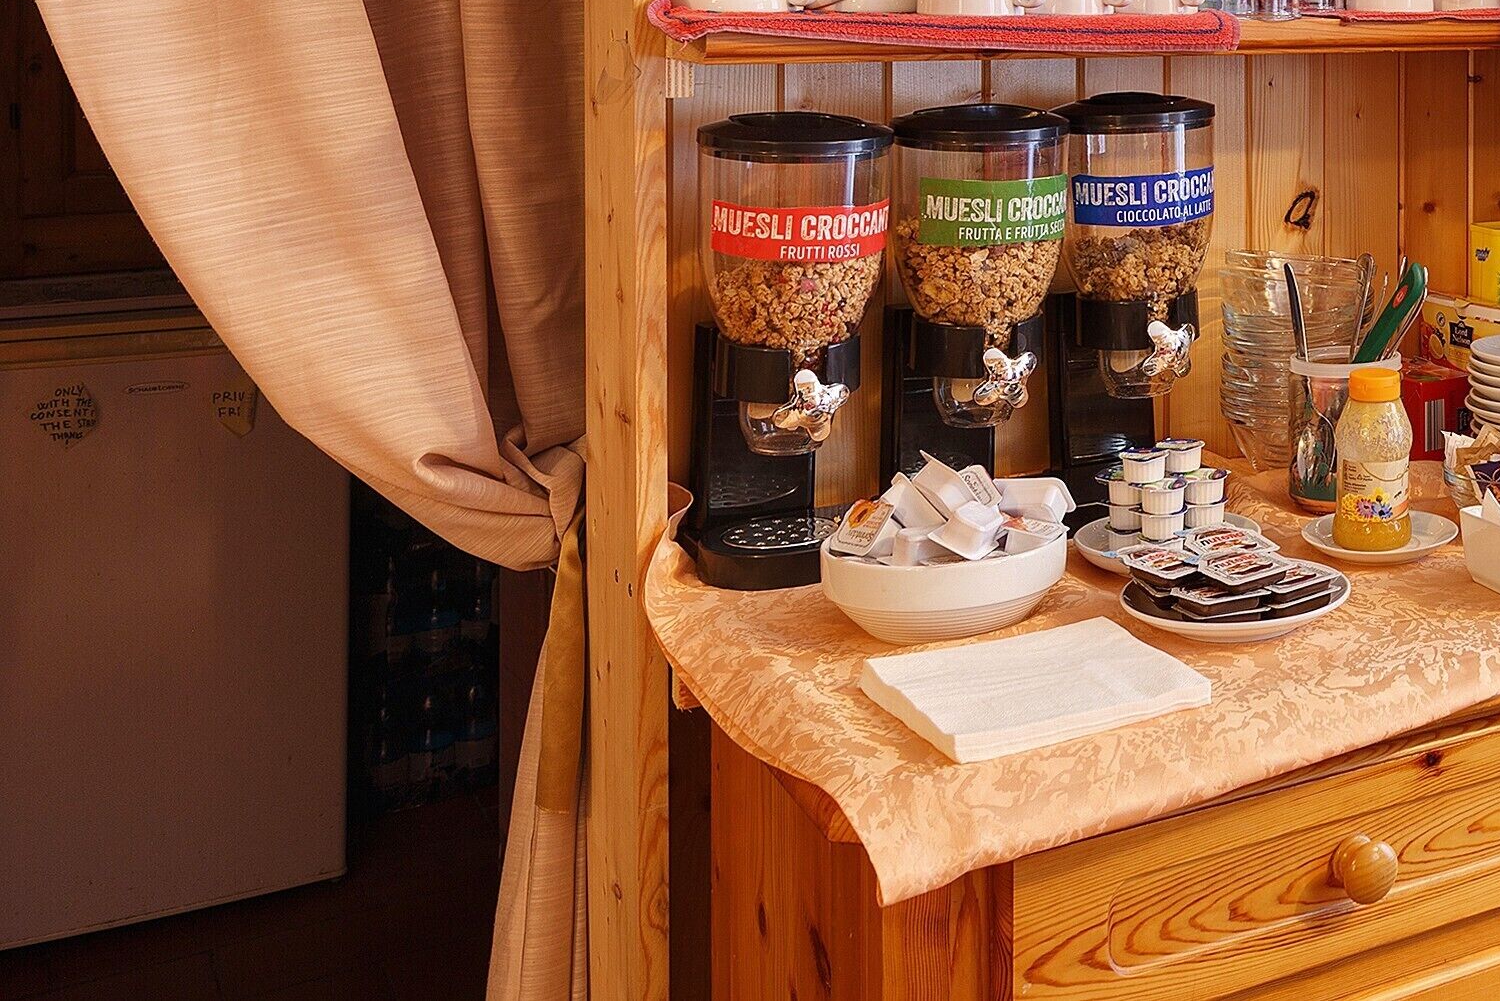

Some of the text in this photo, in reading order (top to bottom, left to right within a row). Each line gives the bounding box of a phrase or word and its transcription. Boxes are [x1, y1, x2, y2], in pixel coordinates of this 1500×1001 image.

[1075, 182, 1147, 206] MUESLI
[926, 195, 1002, 223] MUESLI
[1117, 199, 1211, 223] CIOCCOLATO AL LATTE
[714, 206, 793, 240] MUESLI
[959, 227, 1002, 241] FRUTTA
[1006, 227, 1011, 240] E
[1015, 224, 1049, 239] FRUTTA
[780, 243, 860, 260] FRUTTI ROSSI
[54, 385, 85, 397] ONLY
[36, 398, 93, 410] WITH THE
[31, 408, 89, 420] CONSENT
[40, 420, 71, 431] THE
[1200, 531, 1246, 546] nutella
